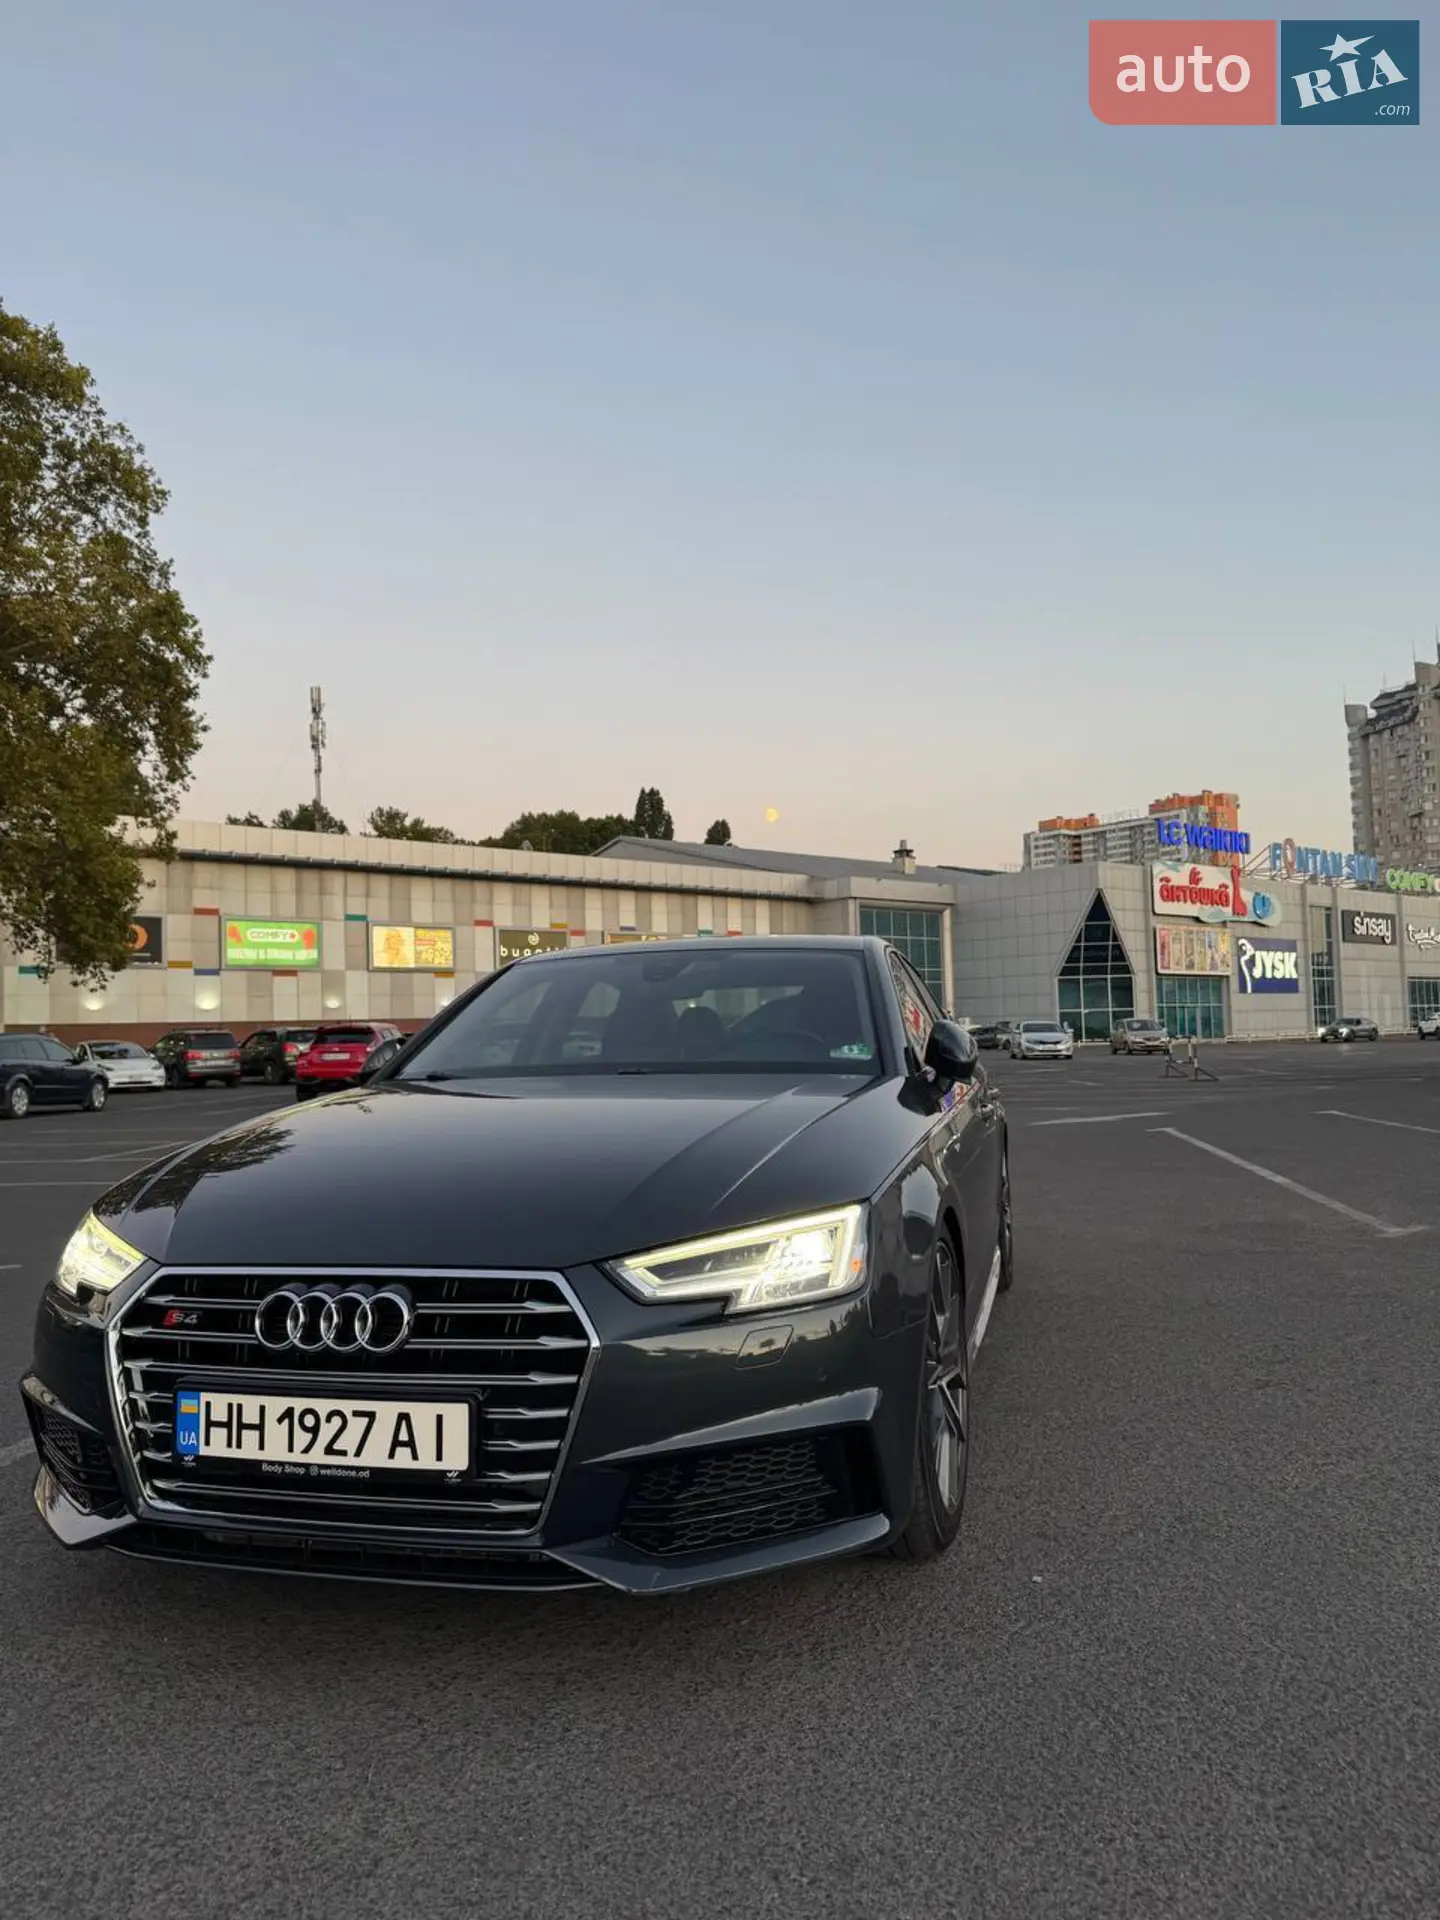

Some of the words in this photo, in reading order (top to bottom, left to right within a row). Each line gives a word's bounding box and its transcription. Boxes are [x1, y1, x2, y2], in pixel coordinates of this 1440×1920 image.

[1155, 818, 1182, 846] LC
[1354, 911, 1391, 944] sinsay
[1252, 950, 1298, 979] JYSK
[179, 1430, 198, 1446] UA
[262, 1462, 283, 1474] Body
[284, 1464, 305, 1475] Shop
